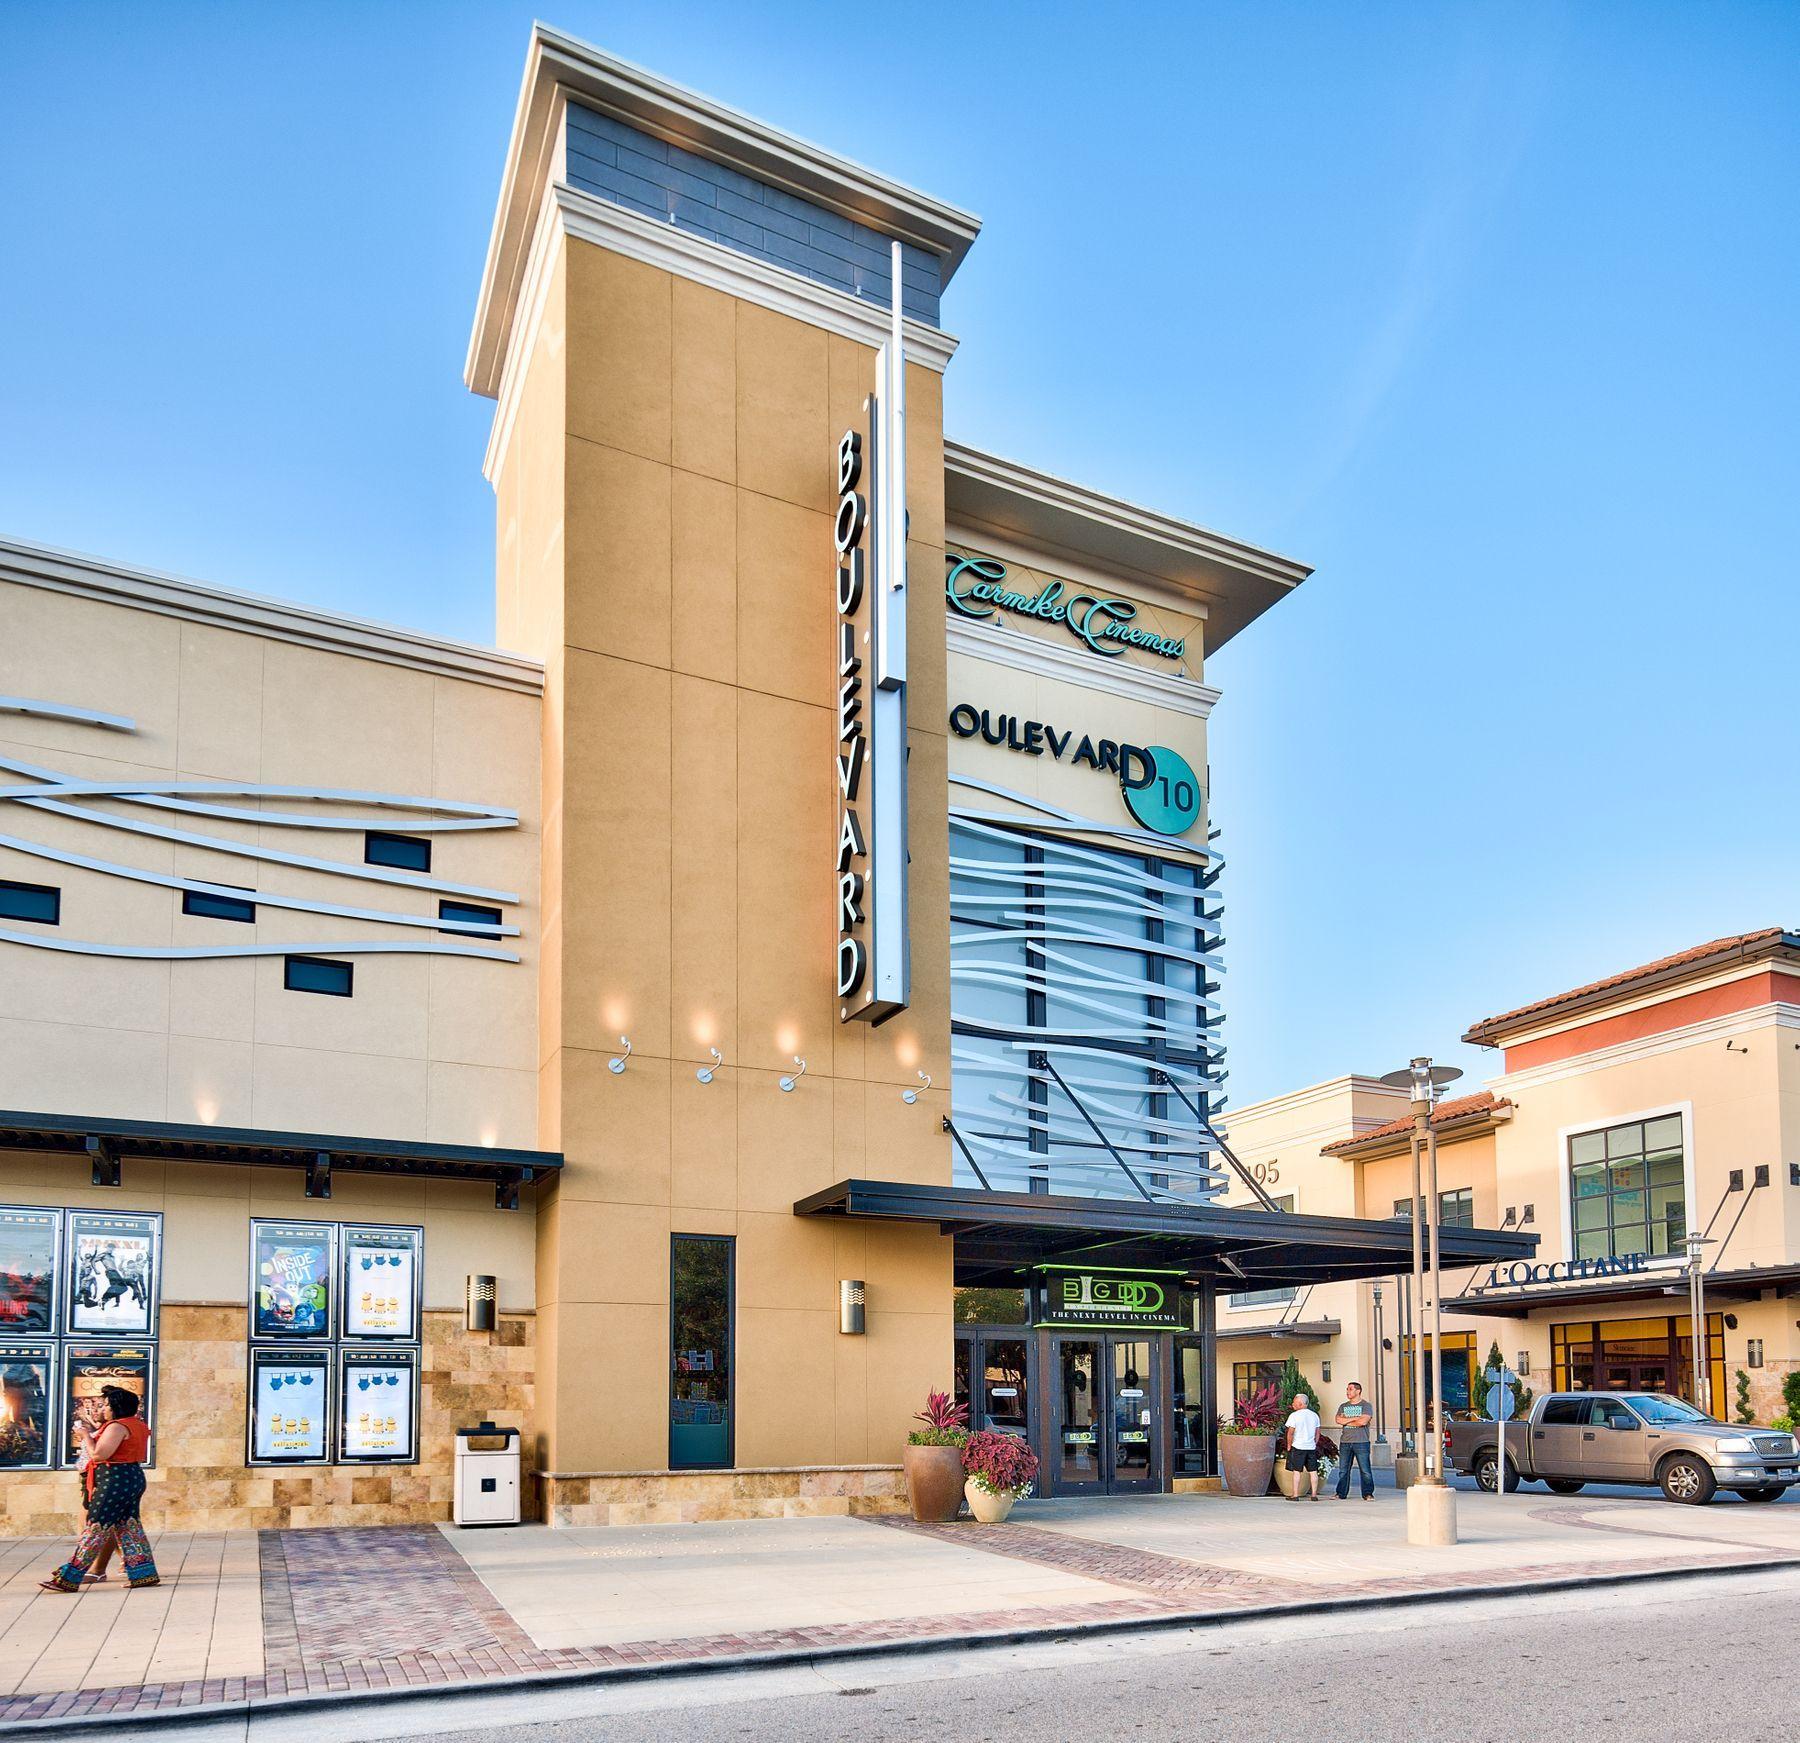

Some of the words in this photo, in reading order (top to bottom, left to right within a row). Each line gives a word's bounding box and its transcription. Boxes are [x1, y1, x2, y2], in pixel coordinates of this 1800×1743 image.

[946, 553, 1067, 623] Carmike
[1064, 594, 1185, 660] Cinemas
[835, 430, 867, 998] BOULEVARD
[1158, 776, 1194, 813] 10
[271, 1252, 316, 1274] INSIDE
[285, 1265, 312, 1282] OUT
[1490, 1252, 1649, 1288] L'OCCITANE
[1064, 1276, 1111, 1303] BIG
